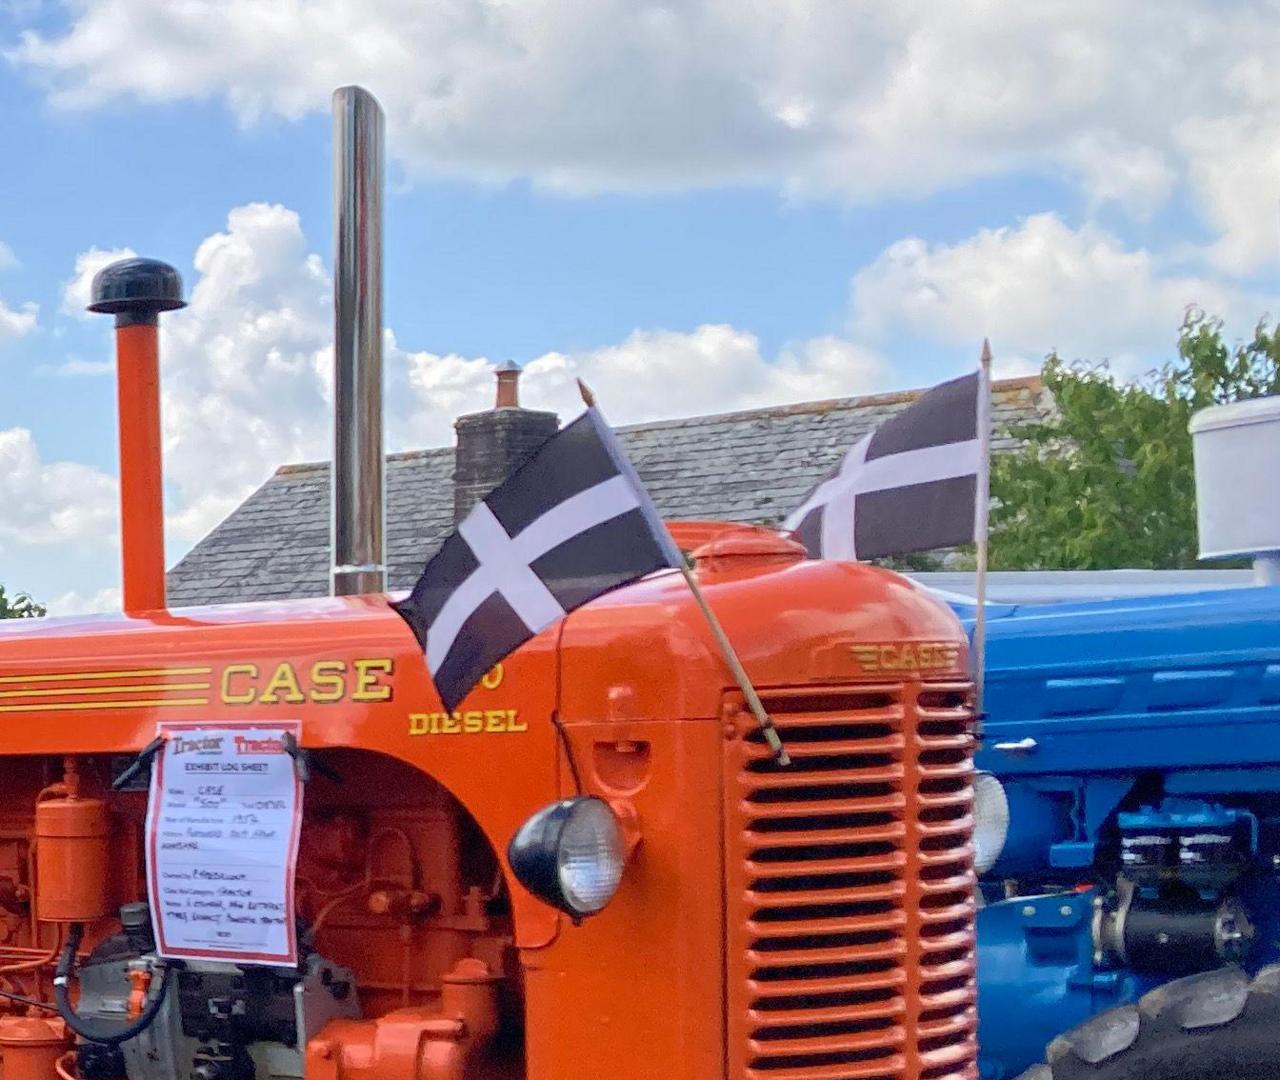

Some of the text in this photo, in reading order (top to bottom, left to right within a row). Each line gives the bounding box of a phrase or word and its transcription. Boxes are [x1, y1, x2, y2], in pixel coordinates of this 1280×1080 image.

[220, 657, 394, 704] CASE
[408, 710, 528, 736] DIESEL
[172, 736, 224, 754] Tractor
[221, 762, 239, 772] LOG
[241, 762, 269, 772] SHEET
